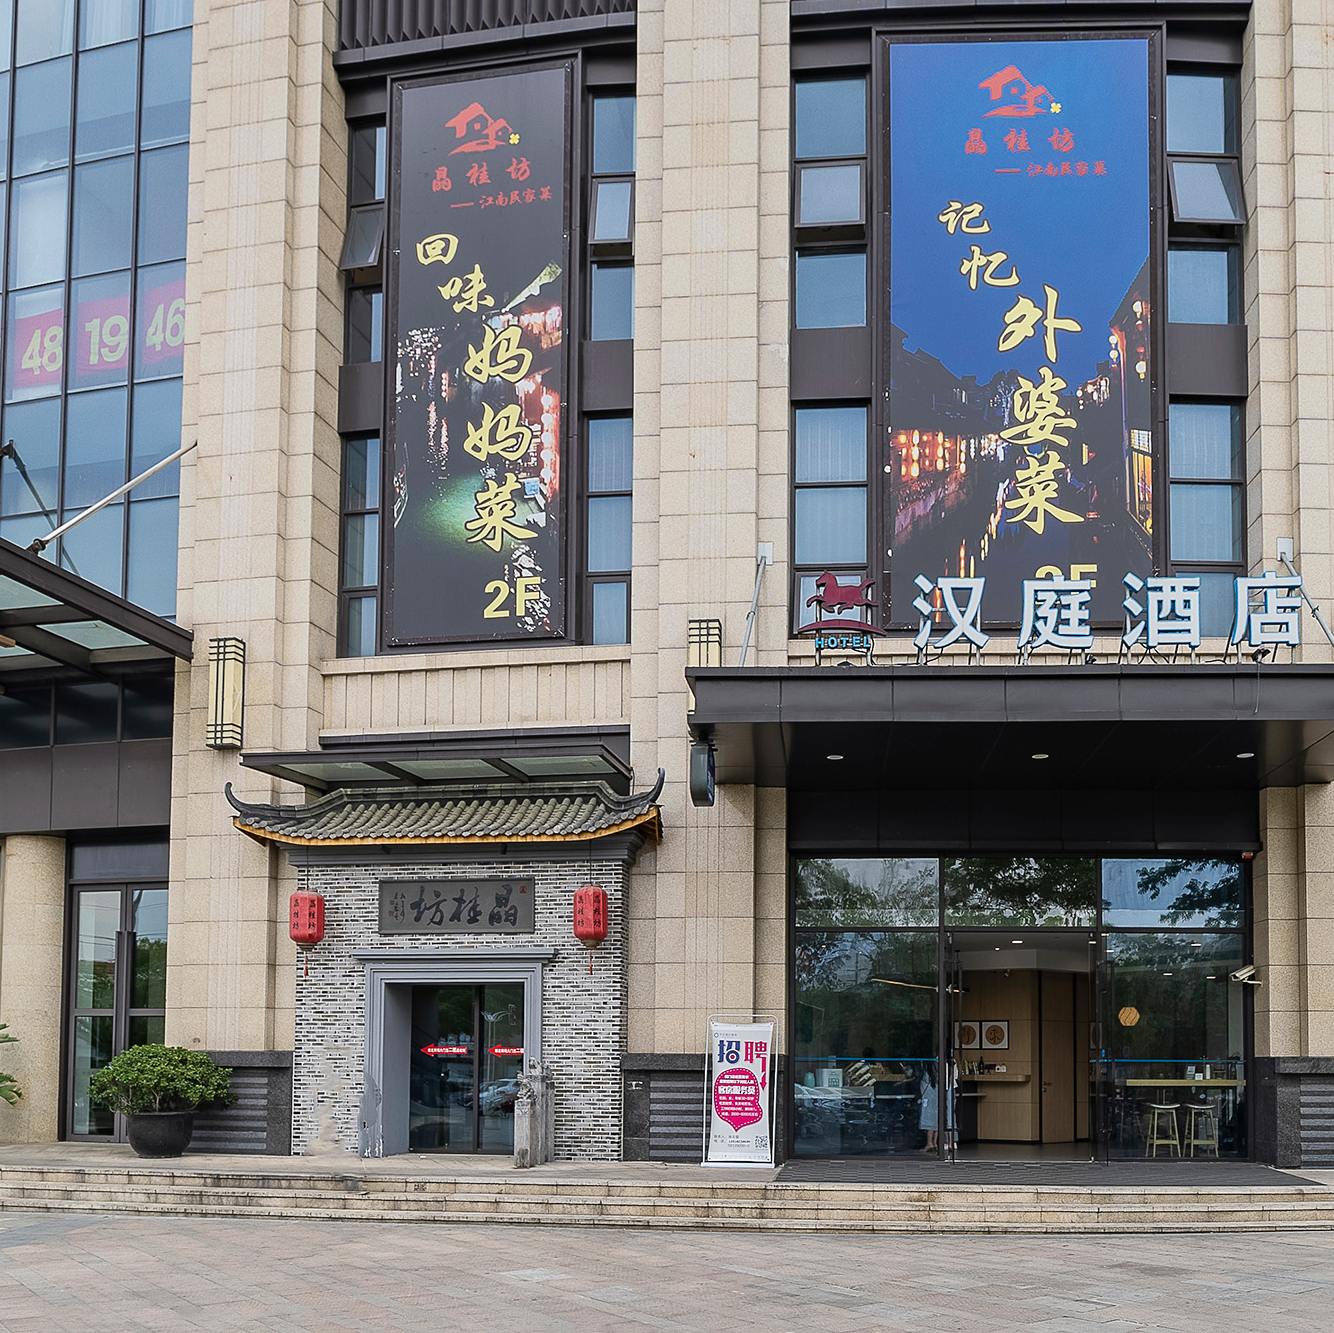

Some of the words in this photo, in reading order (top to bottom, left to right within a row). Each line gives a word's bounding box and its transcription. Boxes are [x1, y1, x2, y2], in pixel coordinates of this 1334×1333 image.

[964, 127, 1076, 155] 晶桂坊
[431, 157, 531, 193] 晶桂坊
[483, 576, 541, 619] 2F
[912, 571, 1304, 650] 汉庭酒店
[814, 636, 872, 649] HOTEL
[717, 1039, 768, 1067] 招聘
